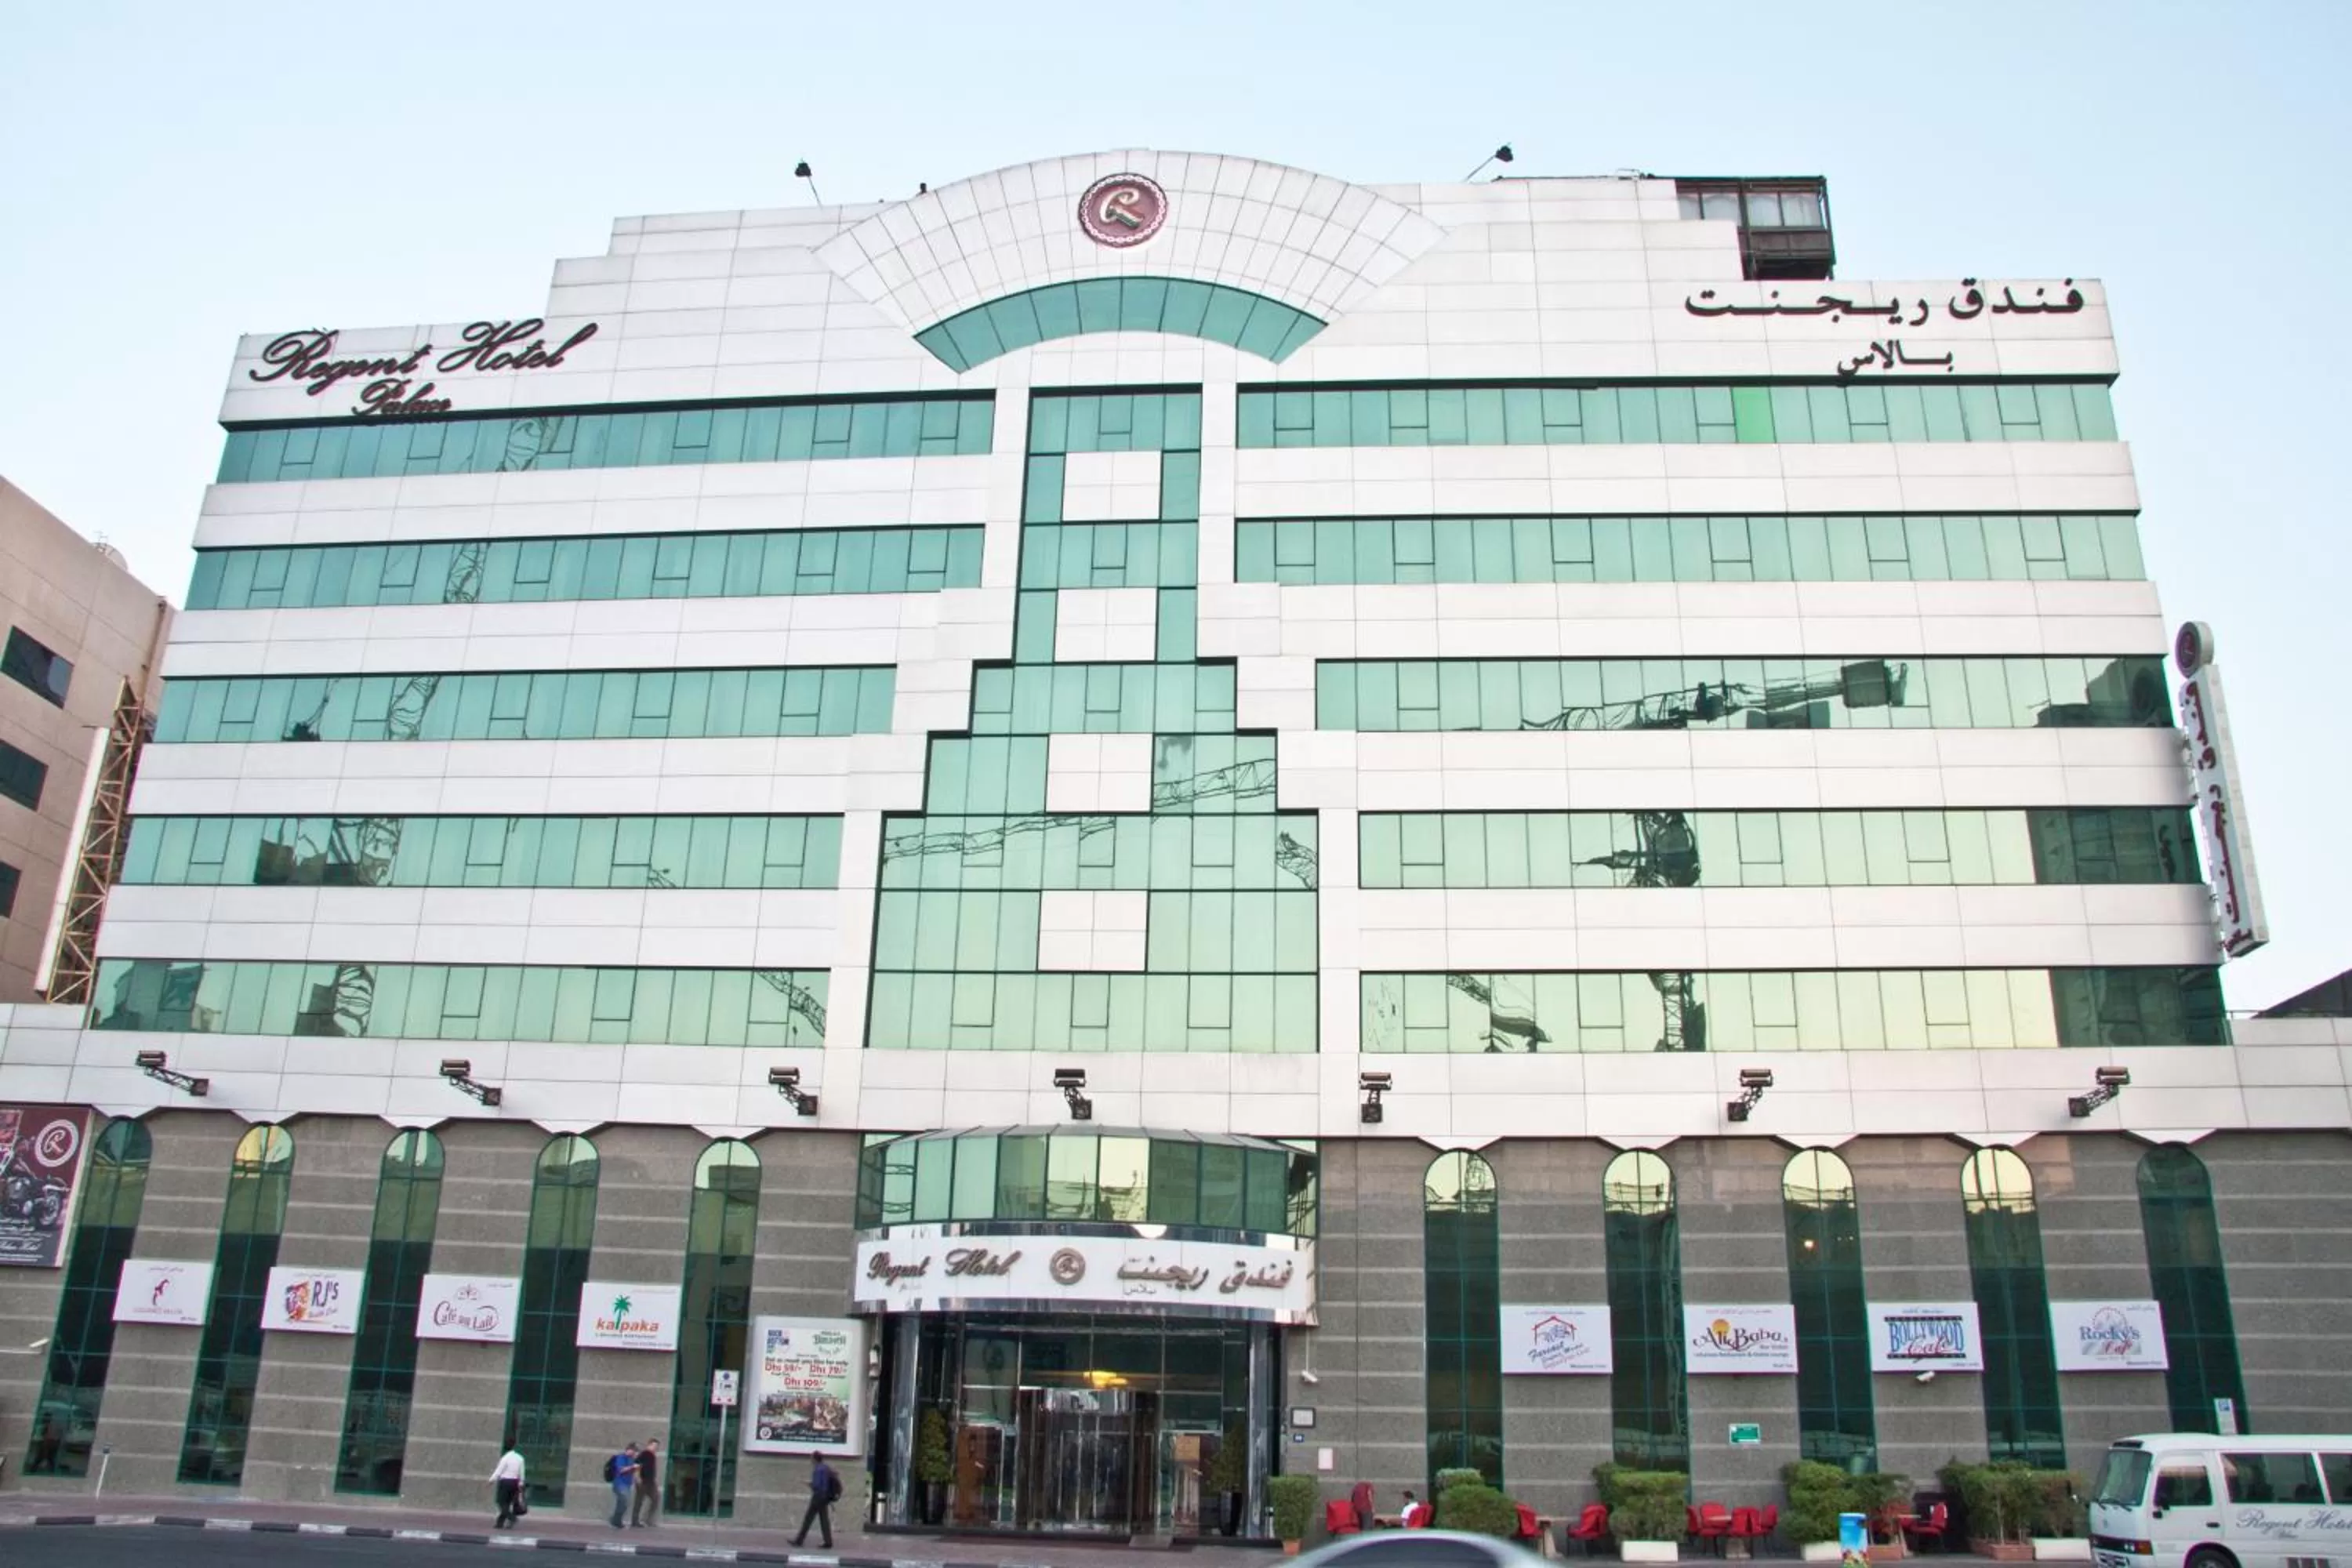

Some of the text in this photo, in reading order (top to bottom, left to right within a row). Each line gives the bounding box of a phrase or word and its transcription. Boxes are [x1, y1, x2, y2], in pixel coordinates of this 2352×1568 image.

[1685, 278, 2084, 326] فندق ريجنت
[249, 318, 599, 396] Regent Hotel
[1837, 339, 1955, 376] بالاس
[351, 378, 452, 417] Palace
[867, 1248, 1022, 1286] Regent Hotel
[1116, 1255, 1294, 1294] فندق ريجنت
[1889, 1320, 1965, 1352] BOLLYWOOD
[2078, 1326, 2140, 1342] Rocky's
[2235, 1508, 2303, 1535] Regent
